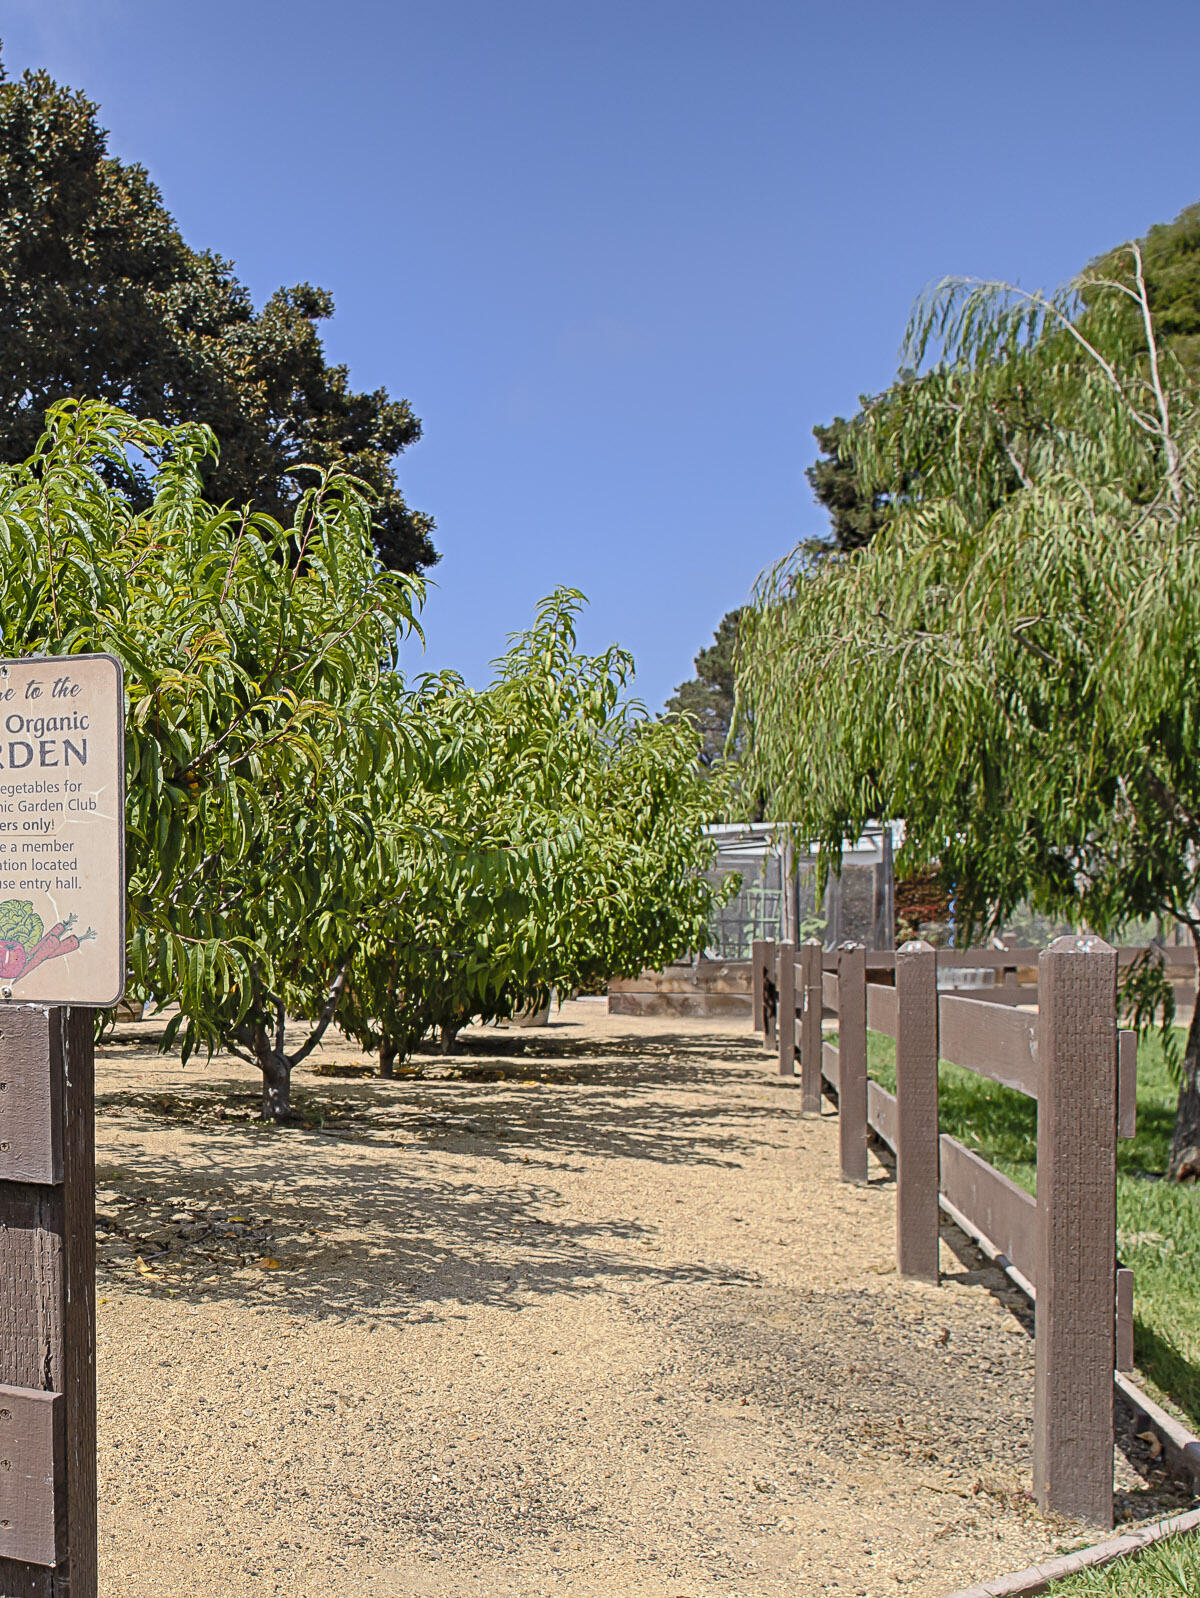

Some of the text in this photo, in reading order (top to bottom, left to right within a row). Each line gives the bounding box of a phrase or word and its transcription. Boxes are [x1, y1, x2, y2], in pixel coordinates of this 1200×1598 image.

[25, 679, 44, 699] to
[51, 676, 82, 698] the
[6, 711, 89, 738] Organic
[64, 780, 82, 793] for
[18, 799, 63, 812] Garden
[68, 798, 97, 811] Club
[23, 818, 55, 833] only!
[10, 844, 17, 853] a
[22, 840, 75, 852] member
[32, 858, 77, 871] located
[20, 878, 51, 892] entry
[55, 877, 82, 889] hall.
